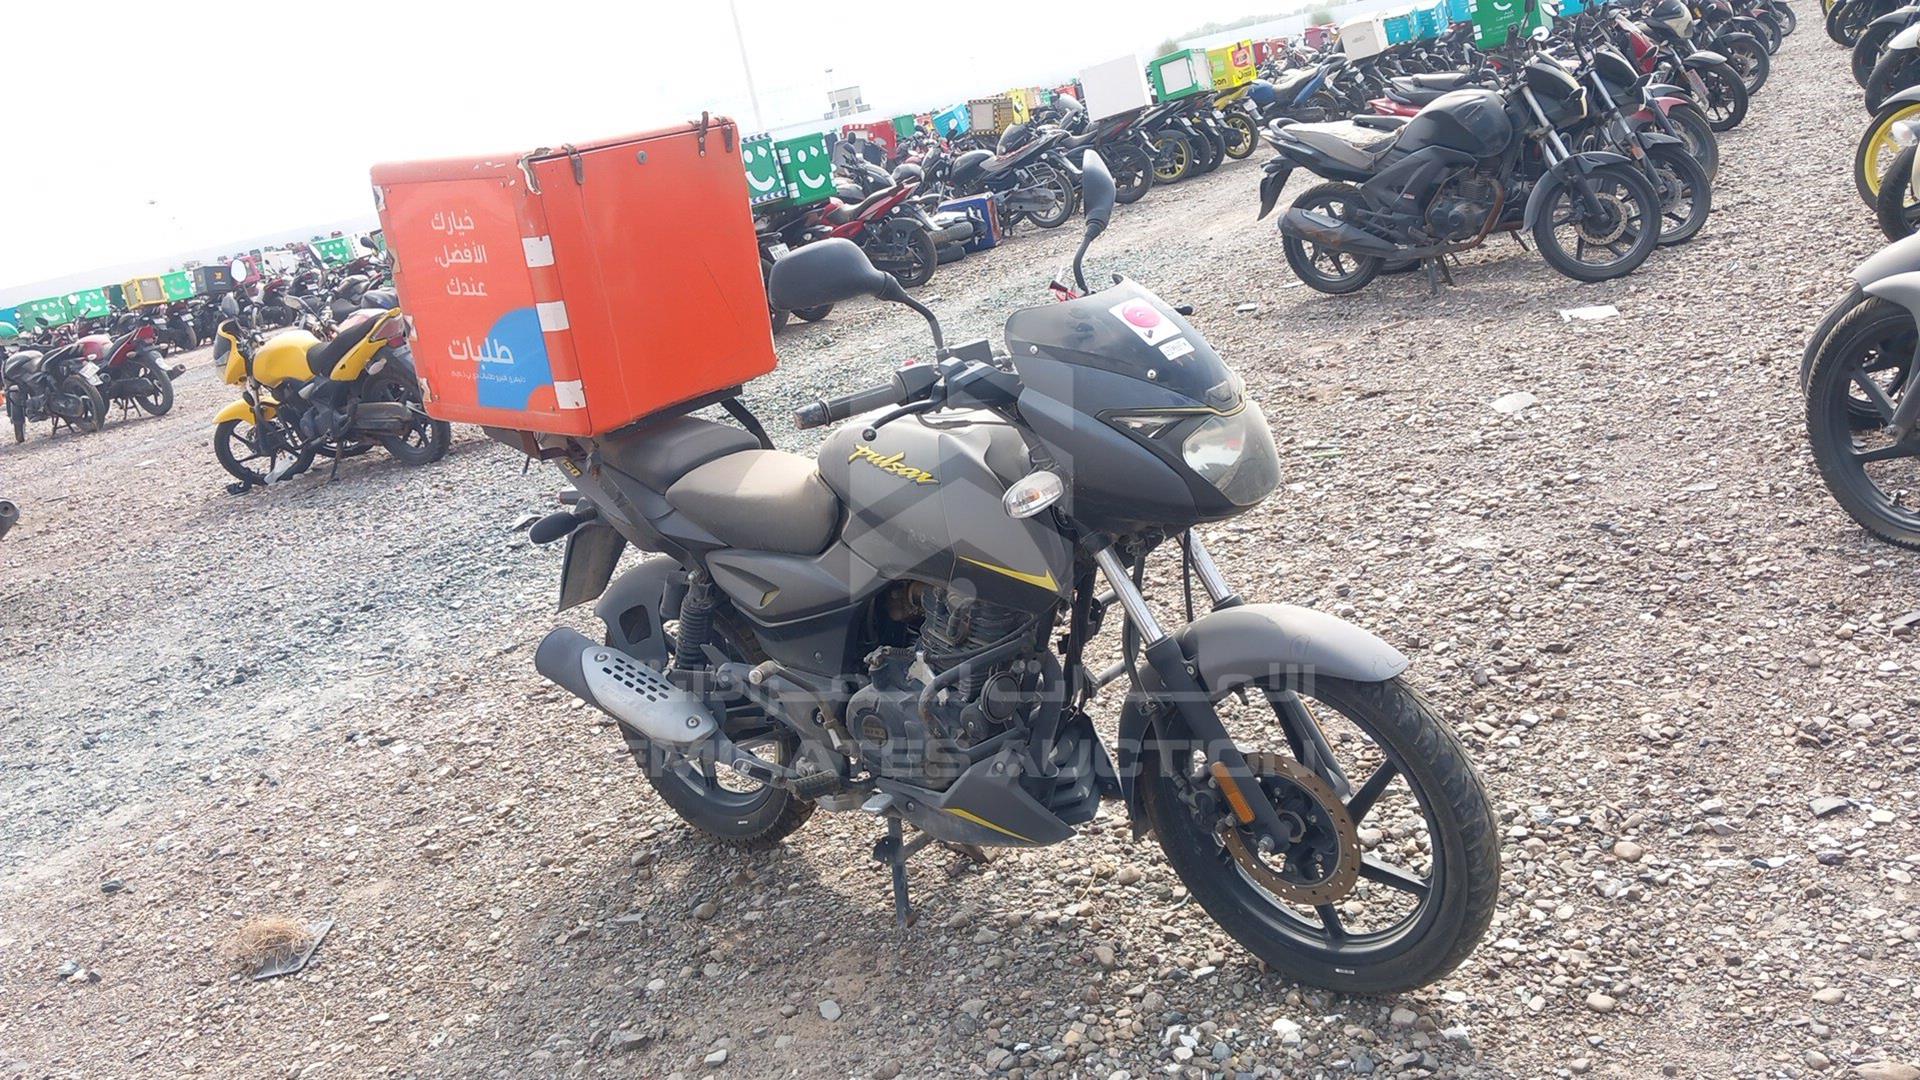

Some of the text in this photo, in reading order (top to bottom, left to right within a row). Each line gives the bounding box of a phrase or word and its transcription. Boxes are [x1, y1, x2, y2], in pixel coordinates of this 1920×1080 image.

[431, 209, 475, 235] خيارك
[446, 276, 488, 297] عندك
[447, 335, 515, 370] طلبات
